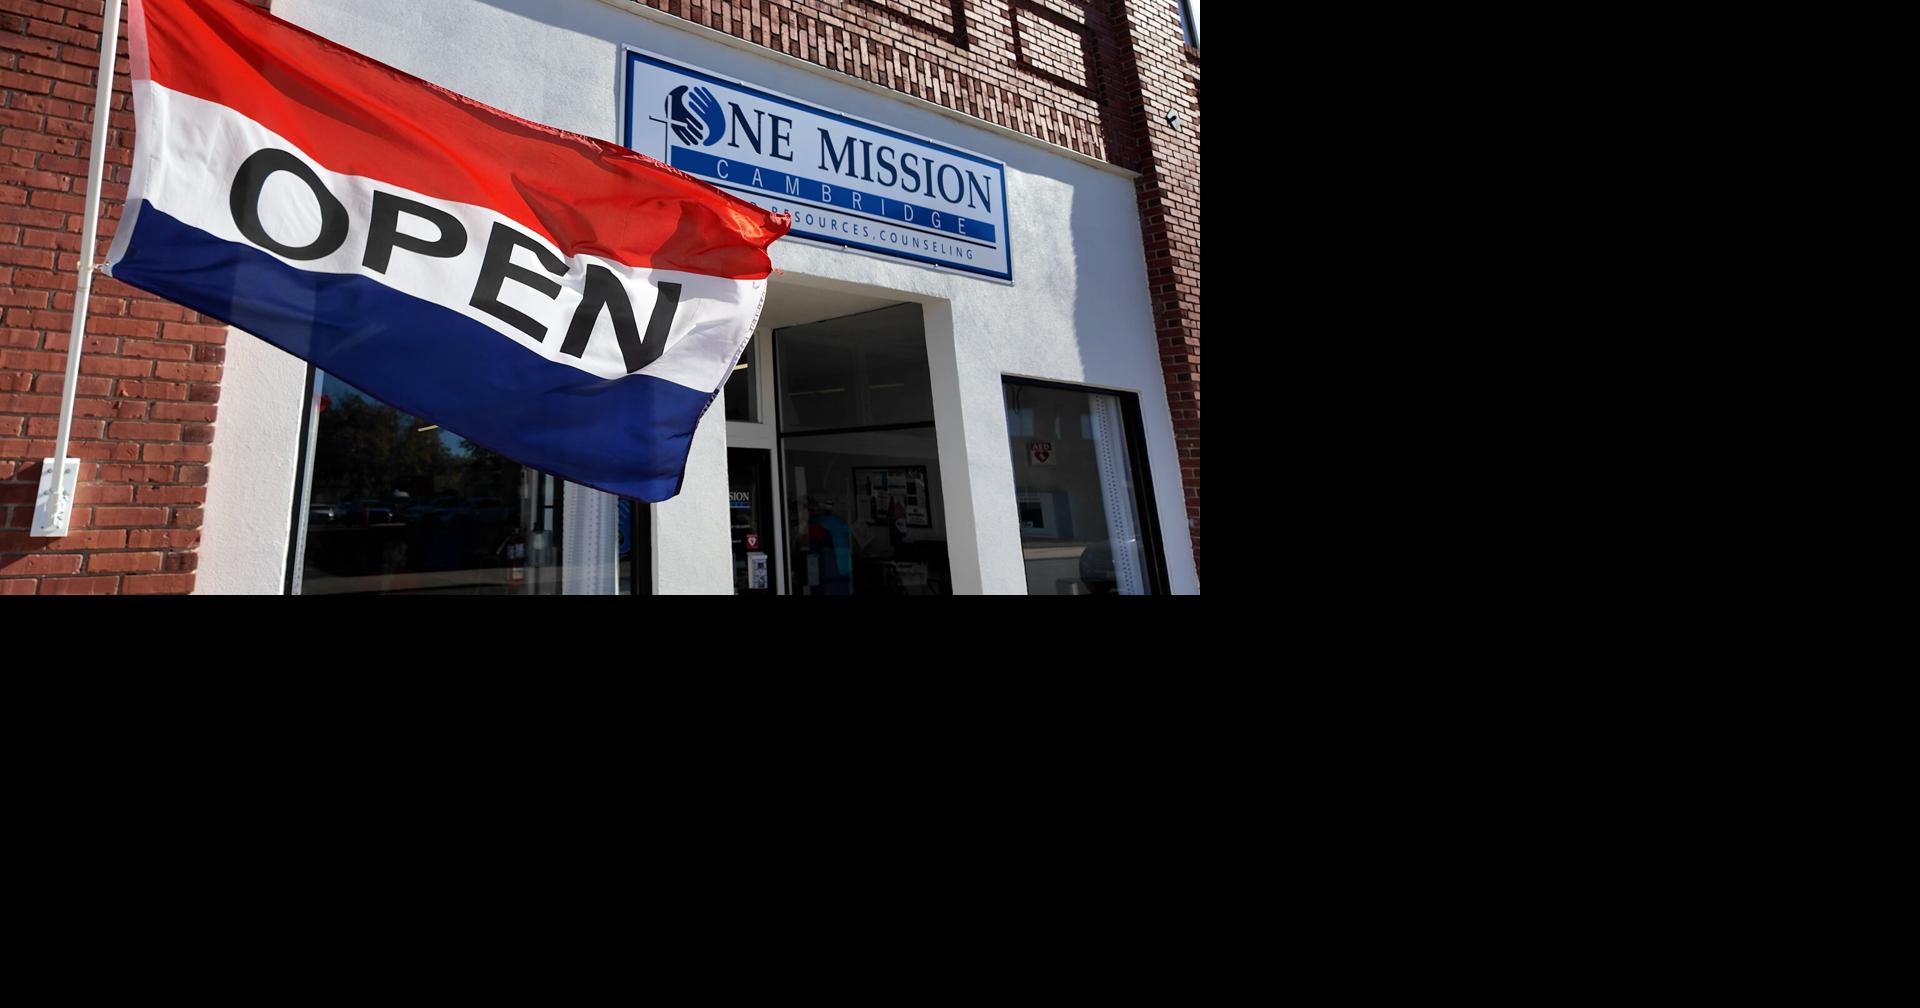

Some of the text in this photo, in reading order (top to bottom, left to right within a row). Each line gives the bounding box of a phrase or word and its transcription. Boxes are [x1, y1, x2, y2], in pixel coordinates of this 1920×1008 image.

[717, 158, 967, 234] CAMBRIDGE
[818, 127, 992, 213] MISSION
[229, 147, 682, 374] OPEN
